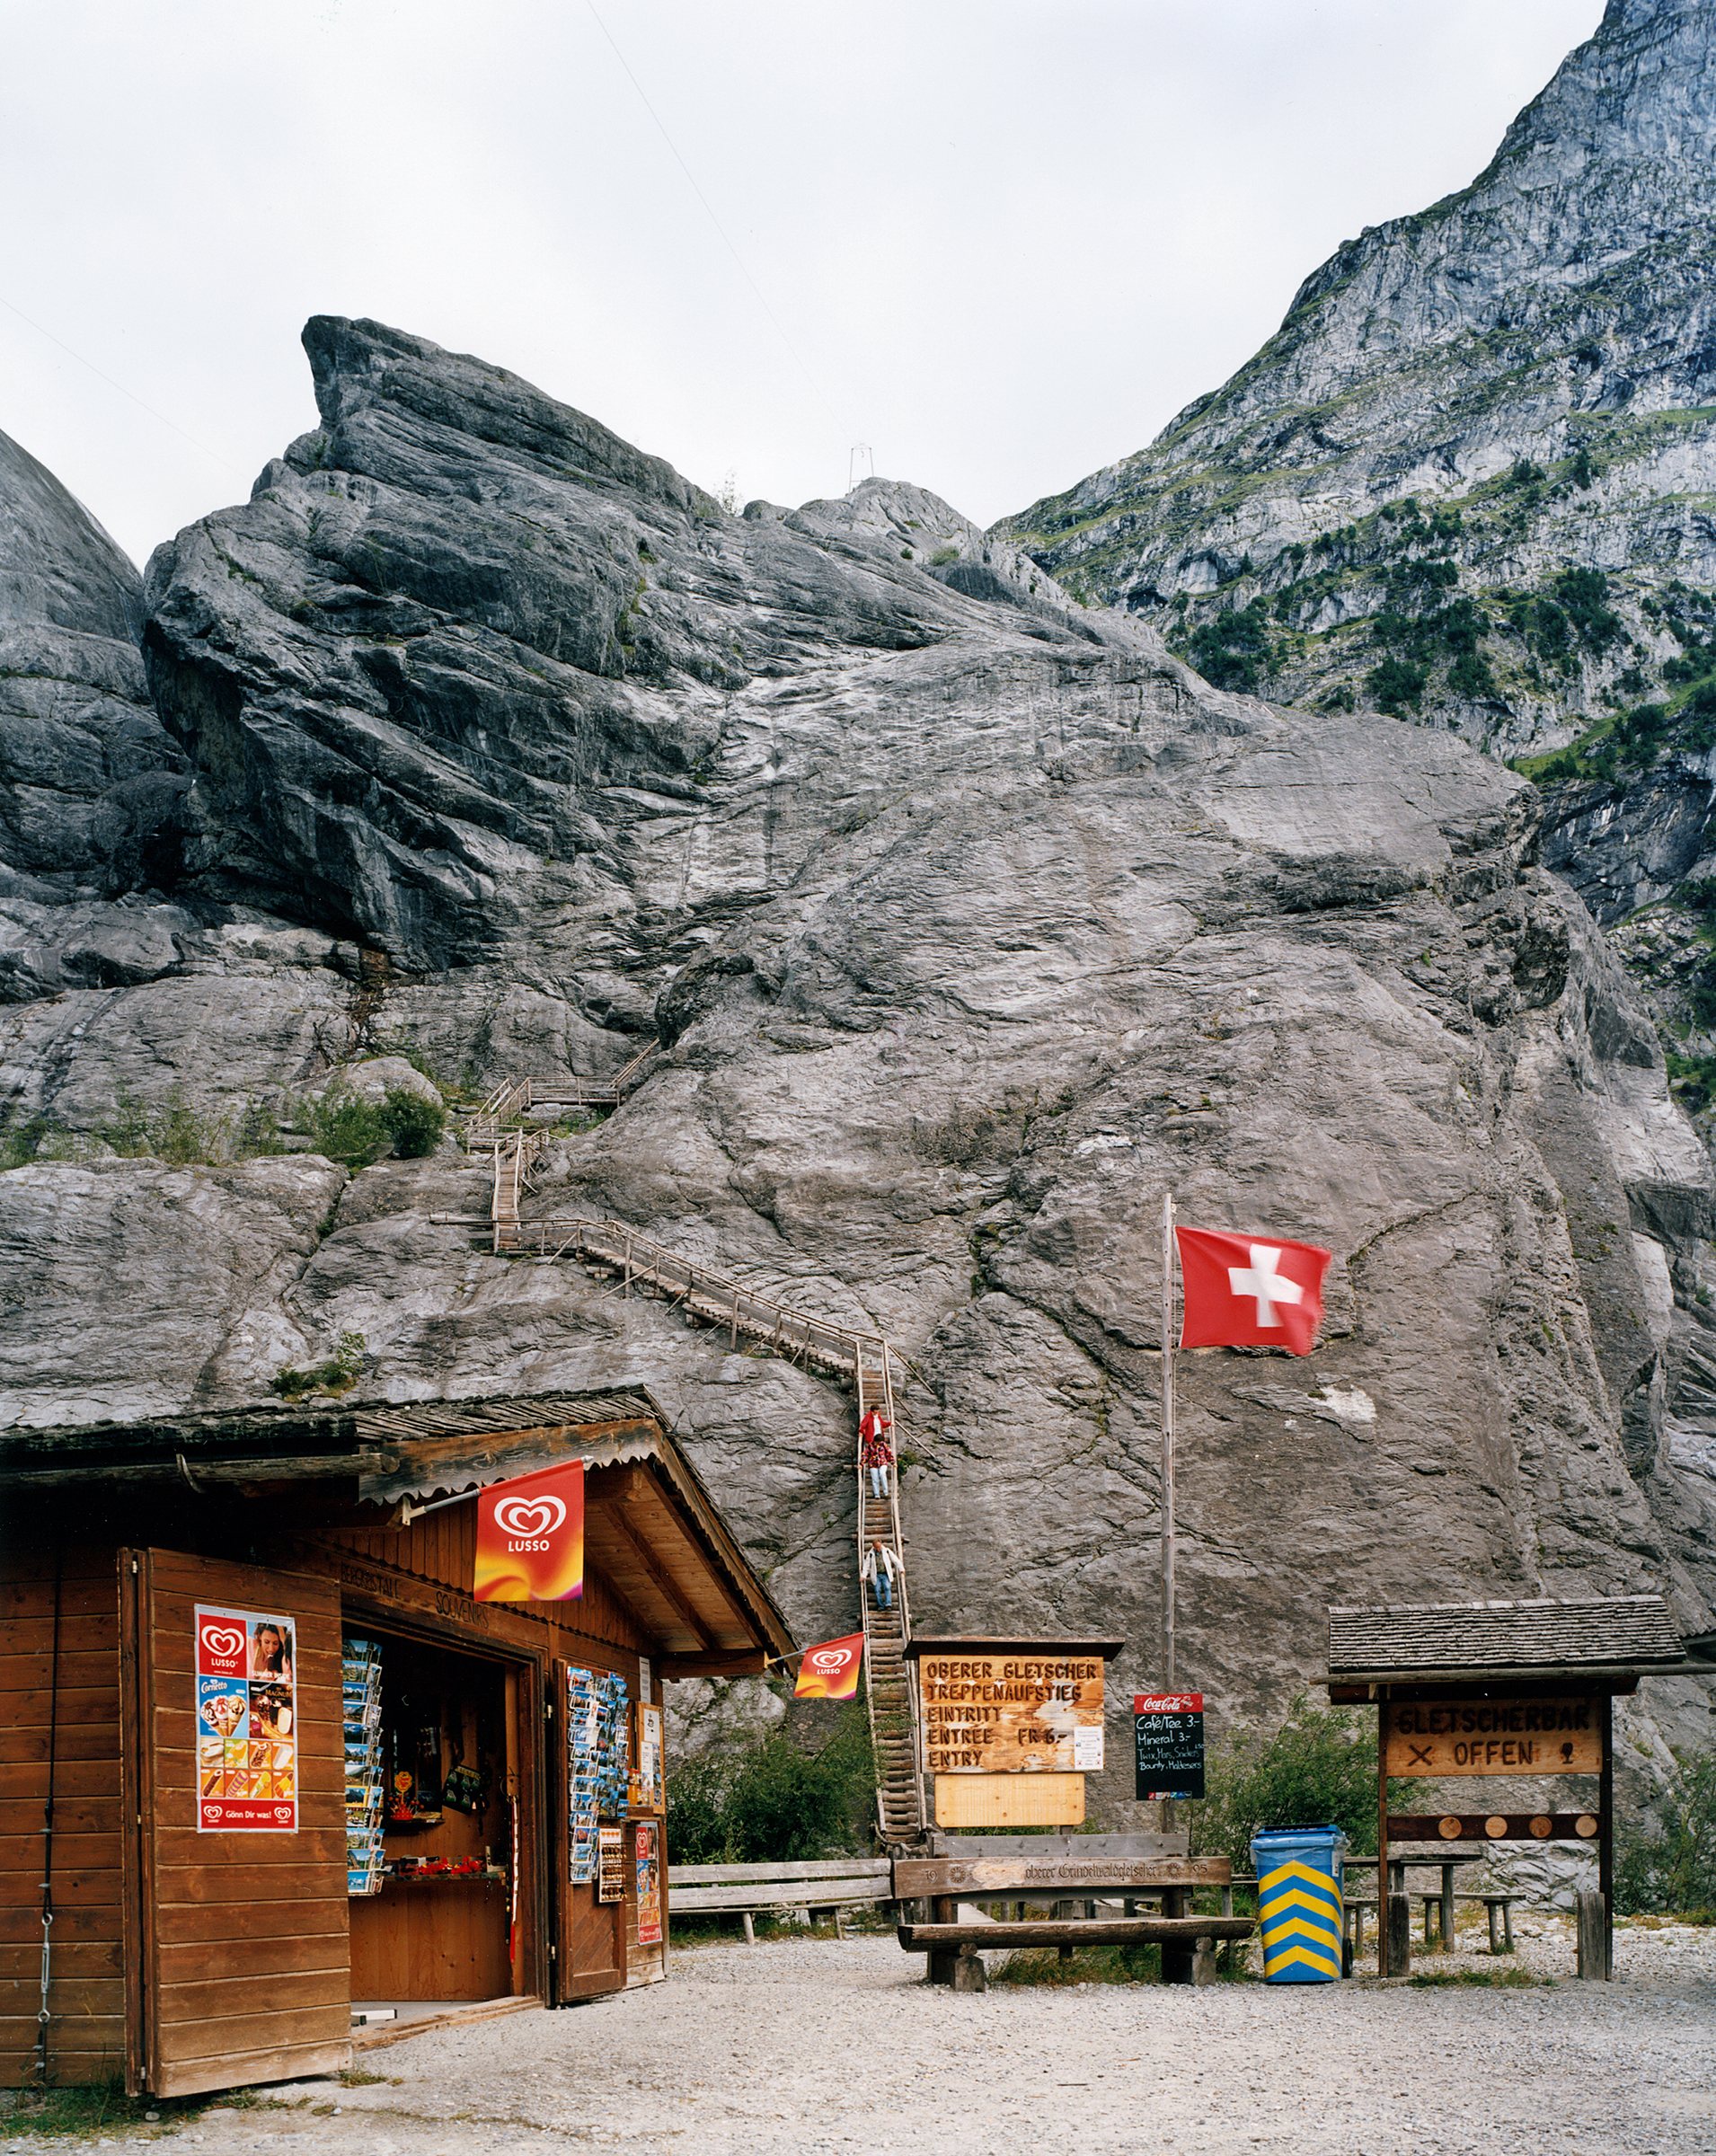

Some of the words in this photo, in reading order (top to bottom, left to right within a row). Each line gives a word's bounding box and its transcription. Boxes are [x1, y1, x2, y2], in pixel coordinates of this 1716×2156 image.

[508, 1540, 550, 1552] LUSSO
[436, 1590, 489, 1630] SOUVENIRS
[211, 1657, 236, 1668] LUSSO
[926, 1661, 993, 1679] OBERER
[1004, 1662, 1097, 1679] GLETSCHER
[200, 1681, 227, 1694] Cornetto
[927, 1683, 1082, 1701] TREPPENAUFSTIEG
[1143, 1696, 1181, 1711] Coca-Cola
[927, 1706, 1003, 1723] EINTRITT
[1397, 1705, 1590, 1735] GLETSCHERBAR
[1136, 1715, 1182, 1731] Café/Tee
[927, 1727, 994, 1745] ENTREE
[1137, 1730, 1175, 1745] Mineral
[928, 1750, 984, 1767] ENTRY
[1455, 1740, 1534, 1766] OFFEN
[226, 1810, 243, 1819] Gönn
[244, 1810, 255, 1818] Dir
[257, 1811, 271, 1819] was!
[1025, 1864, 1055, 1878] oberer
